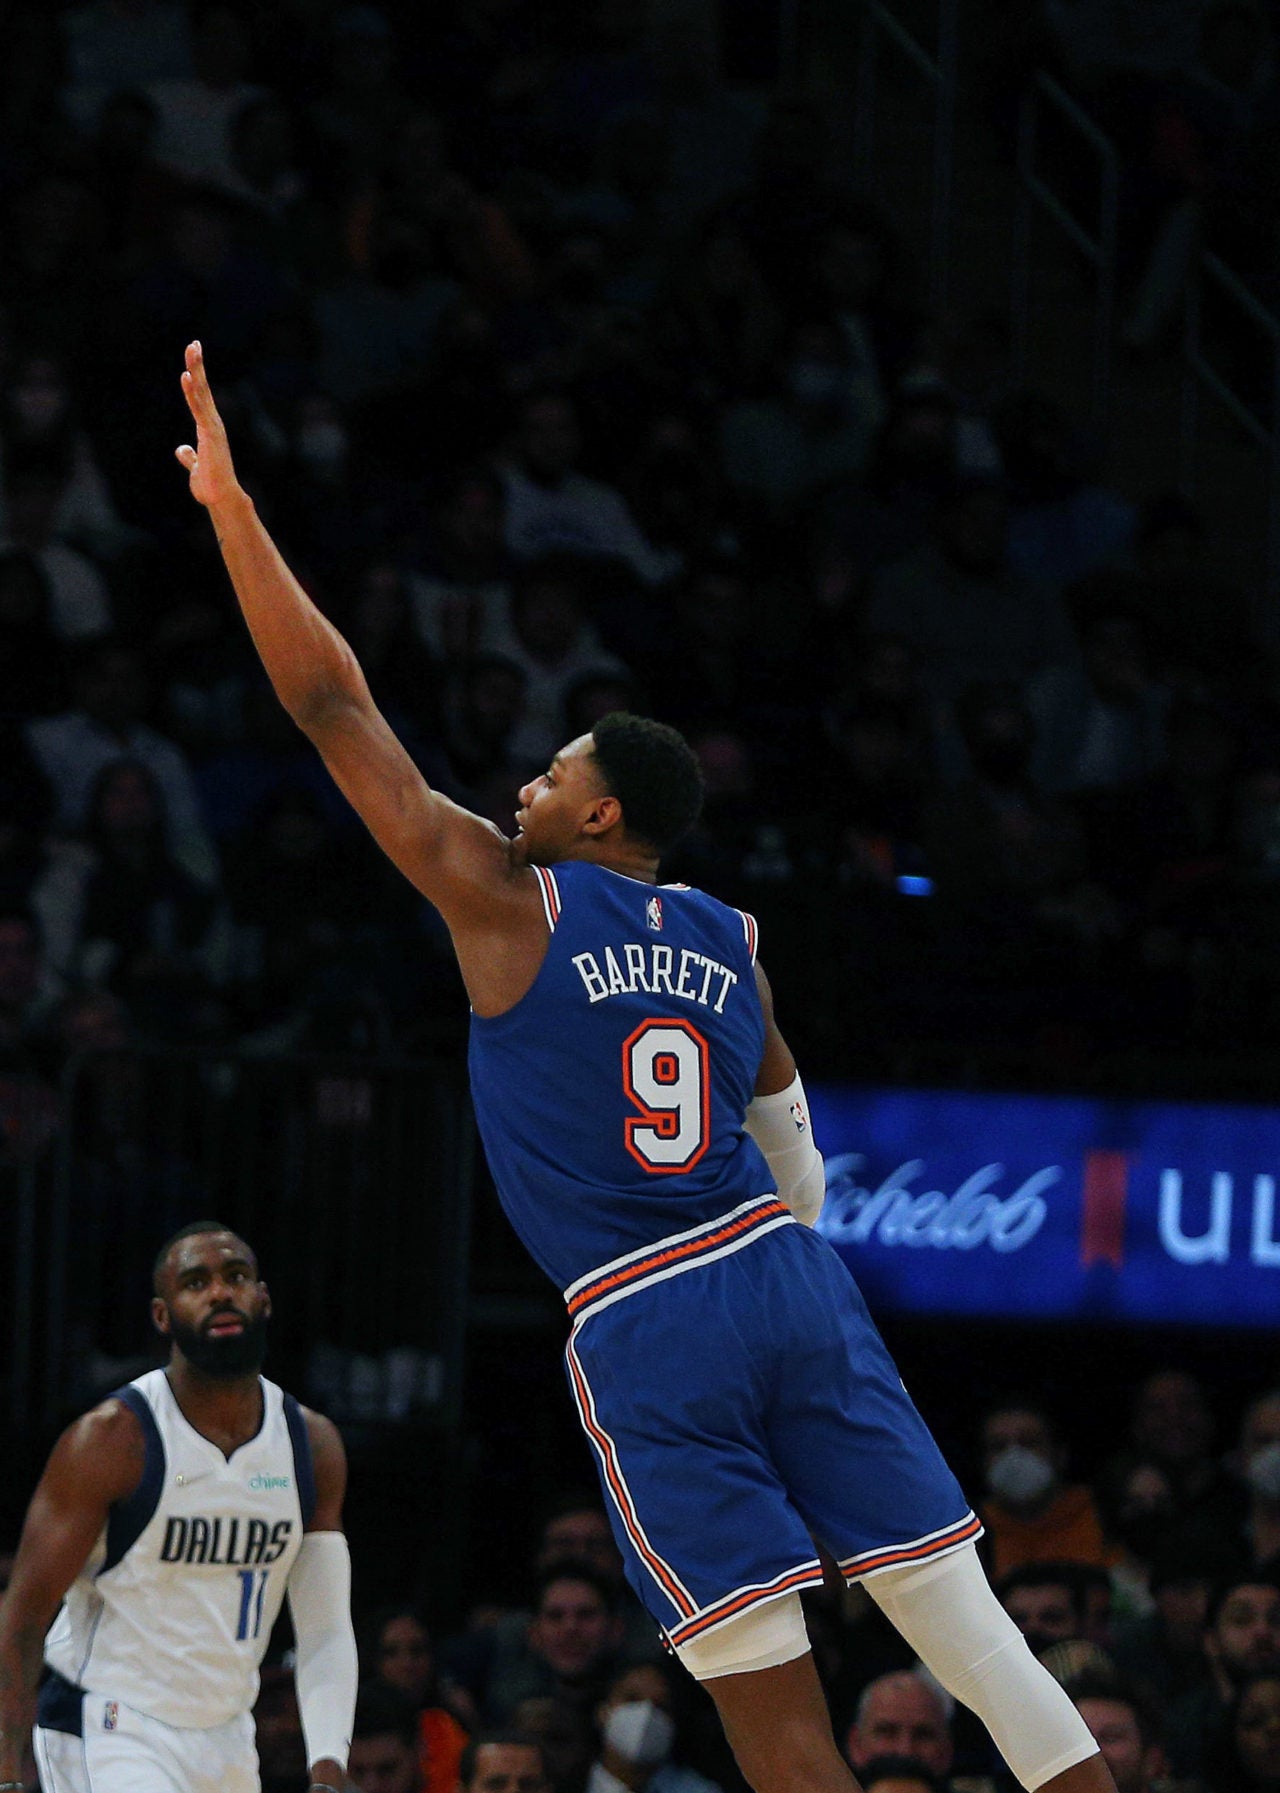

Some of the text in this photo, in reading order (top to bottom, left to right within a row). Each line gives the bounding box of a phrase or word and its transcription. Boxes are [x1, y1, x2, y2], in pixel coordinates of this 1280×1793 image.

[572, 943, 738, 1014] BARRETT
[622, 1018, 710, 1174] 9
[159, 1516, 293, 1564] DALLAS
[235, 1569, 269, 1641] 11
